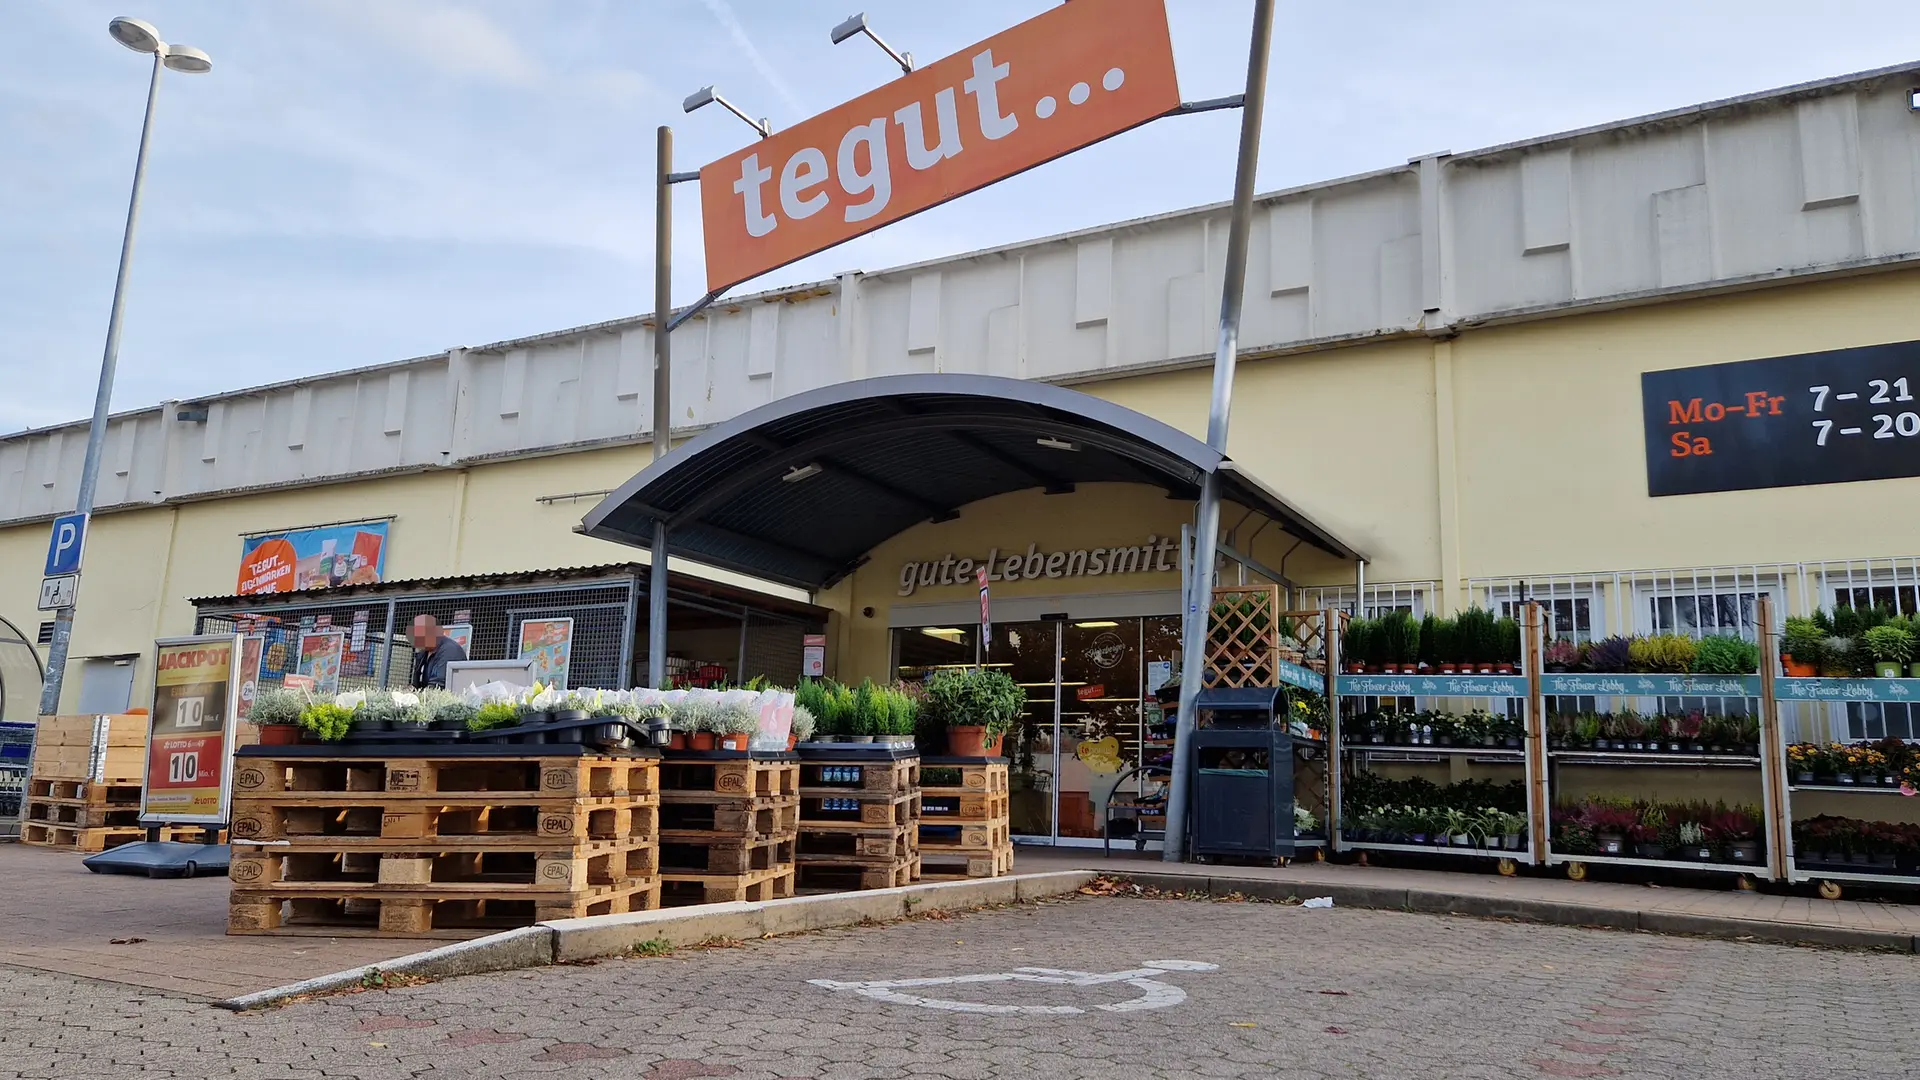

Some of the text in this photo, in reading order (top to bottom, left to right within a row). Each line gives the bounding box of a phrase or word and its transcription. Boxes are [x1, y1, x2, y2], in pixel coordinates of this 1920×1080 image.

[734, 48, 1125, 238] tegut...
[1671, 432, 1713, 457] Sa
[53, 523, 76, 567] P
[897, 553, 974, 597] gute
[158, 648, 230, 671] JACKPOT
[1347, 678, 1412, 695] The Flower Lobby
[1448, 678, 1515, 696] The Flower Lobby
[1551, 677, 1625, 694] The Flower Lobby
[1665, 677, 1682, 691] The
[1783, 681, 1806, 696] The
[1842, 683, 1875, 700] Lobby
[172, 755, 196, 779] 10
[239, 773, 260, 785] EPAL
[722, 777, 742, 788] EPAL
[200, 797, 217, 805] LOTTO
[237, 821, 259, 832] EPAL
[546, 819, 568, 831] EPAL
[547, 865, 566, 876] EPAL
